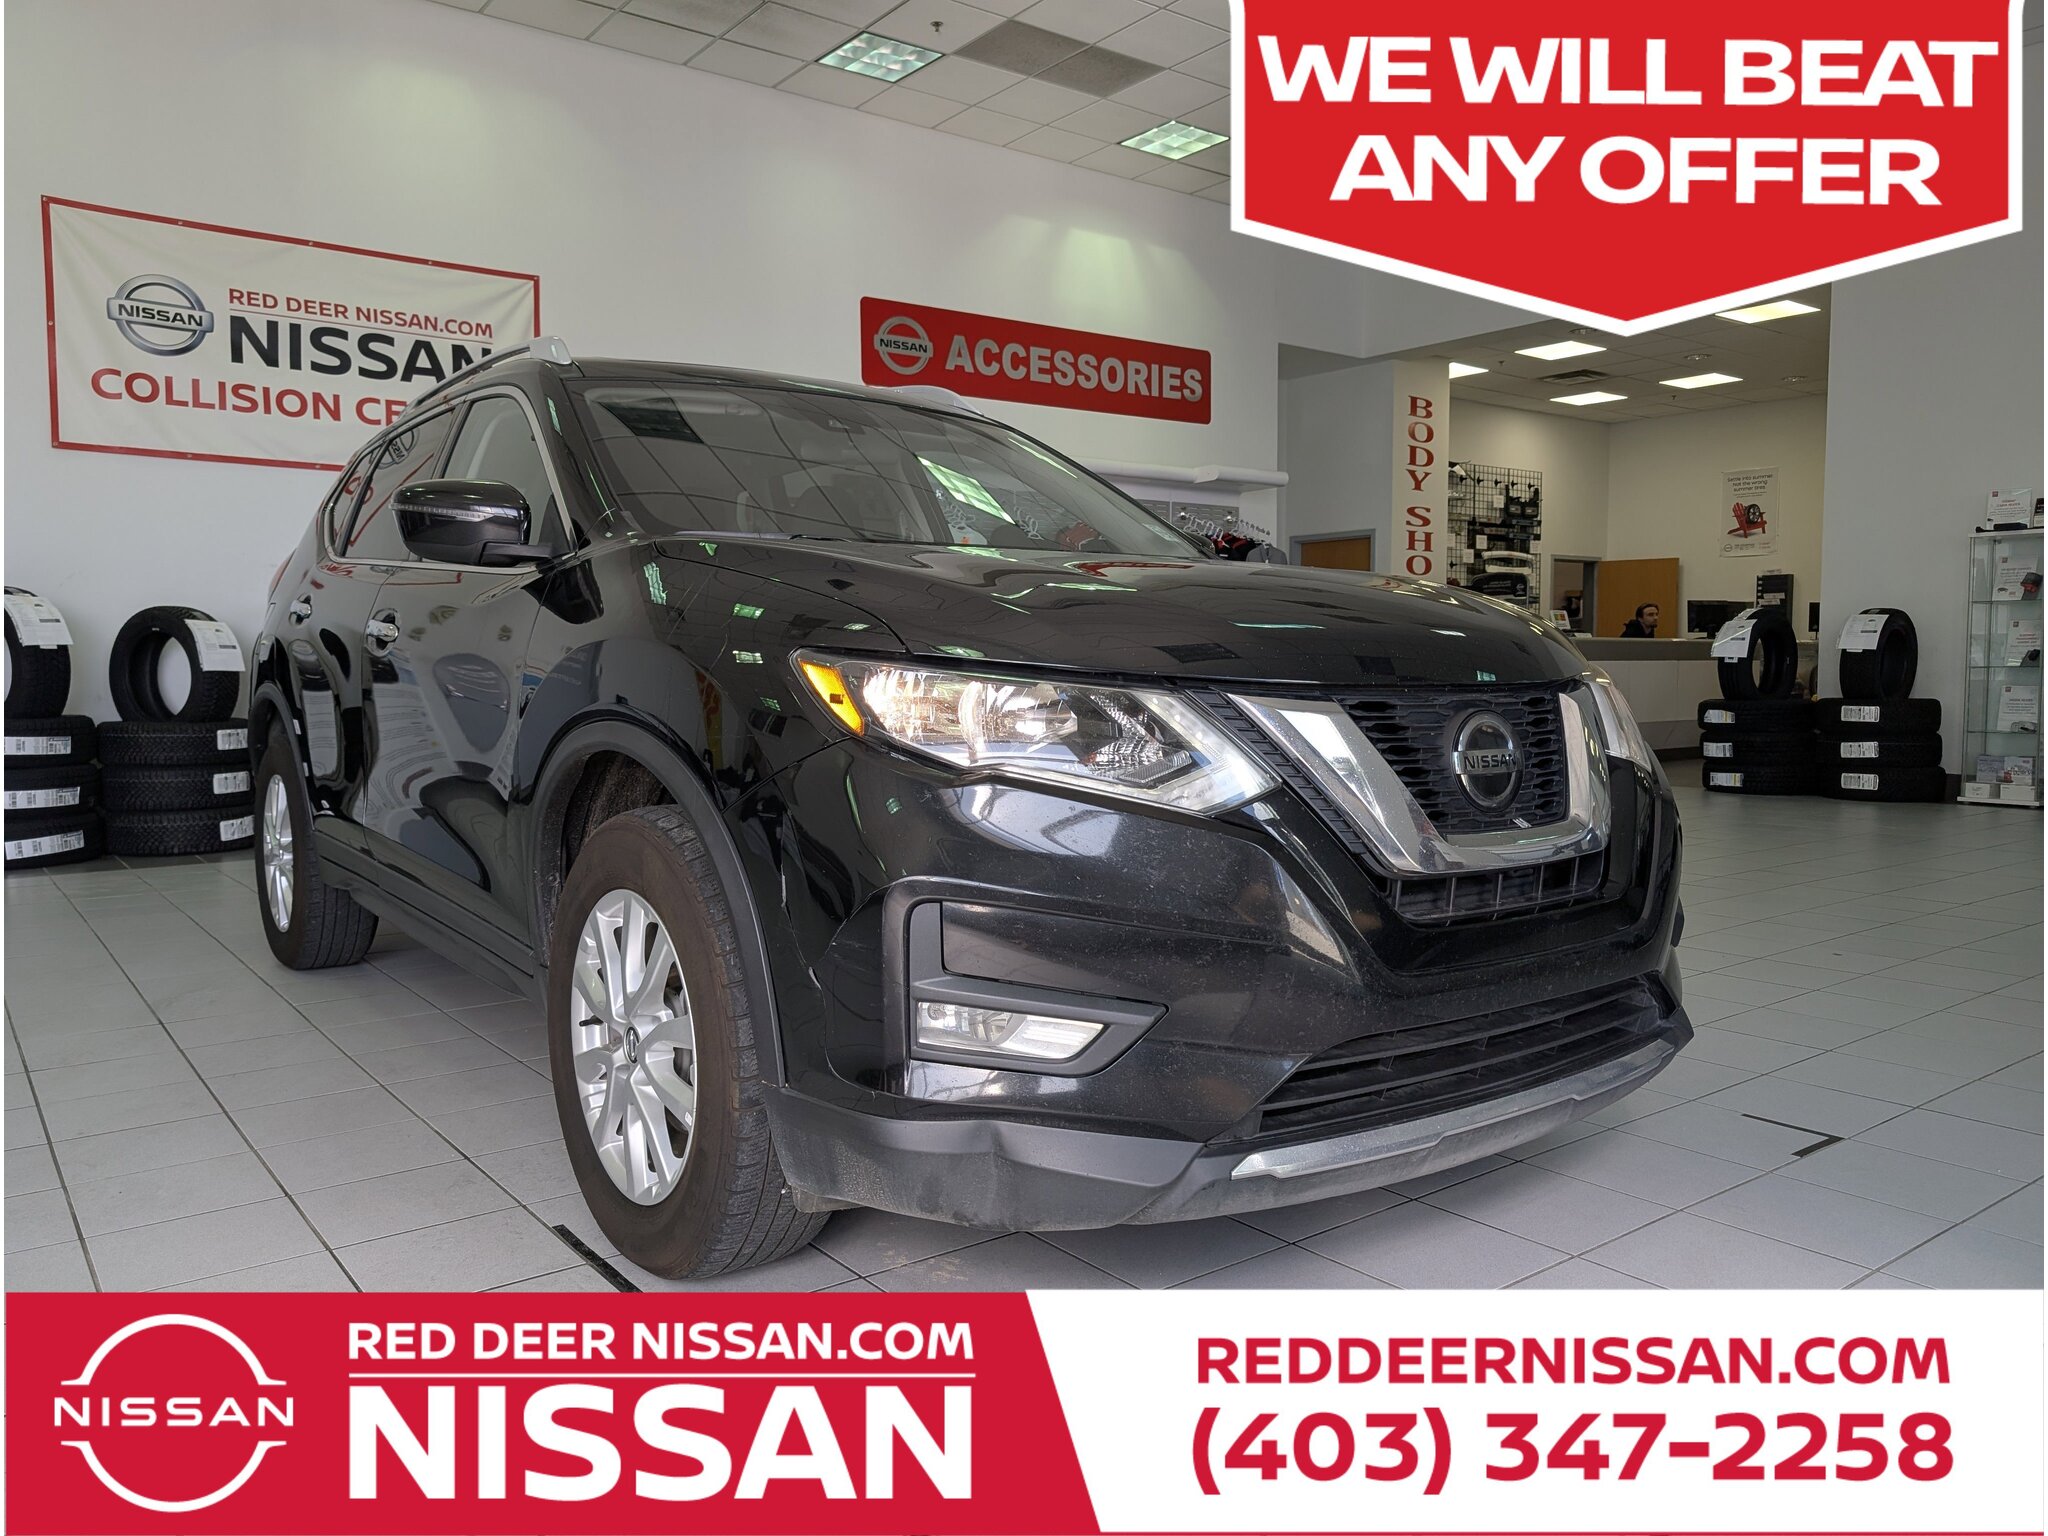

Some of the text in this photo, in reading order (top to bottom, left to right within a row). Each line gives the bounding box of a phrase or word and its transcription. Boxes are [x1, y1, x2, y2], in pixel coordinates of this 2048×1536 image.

[117, 302, 204, 328] NISSAN
[228, 287, 493, 338] RED DEER NISSAN.COM
[878, 337, 929, 355] NISSAN
[944, 333, 1203, 403] ACCESSORIES
[91, 366, 341, 423] COLLISION
[1406, 395, 1435, 492] BODY
[1463, 753, 1517, 770] NISSAN
